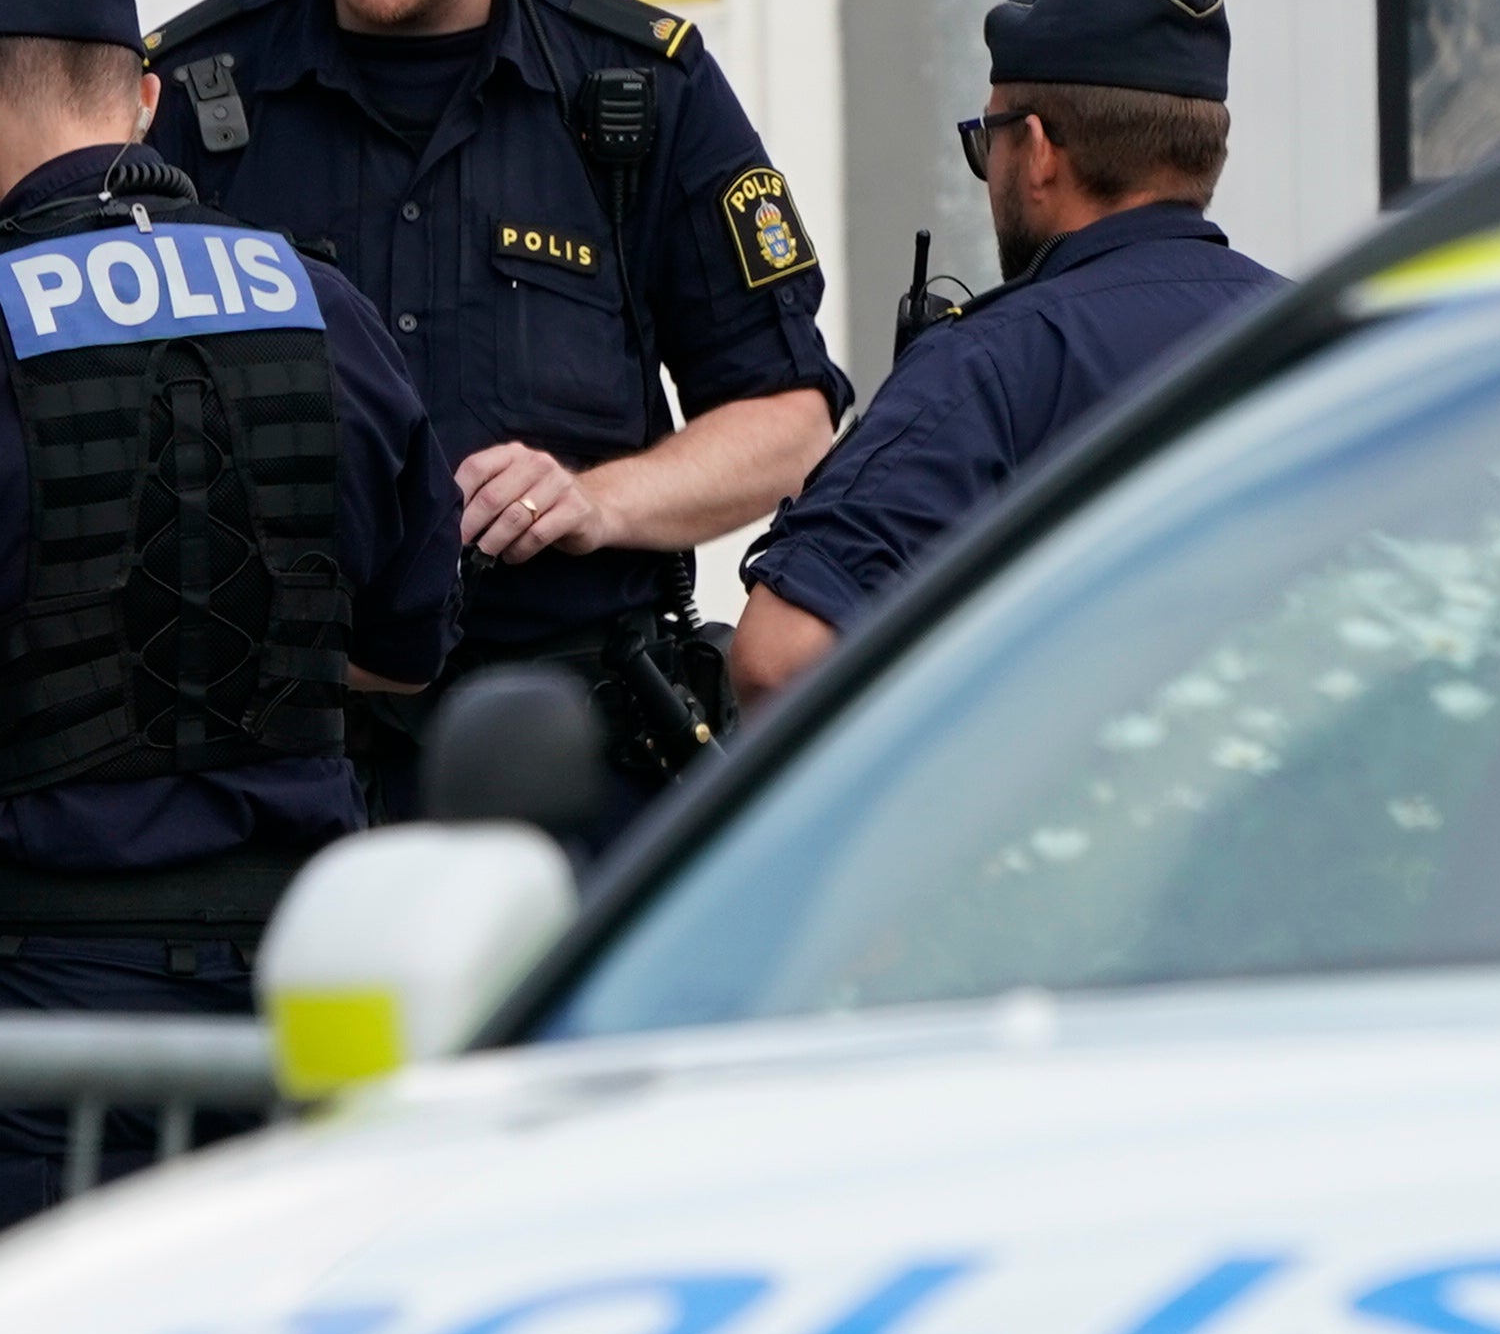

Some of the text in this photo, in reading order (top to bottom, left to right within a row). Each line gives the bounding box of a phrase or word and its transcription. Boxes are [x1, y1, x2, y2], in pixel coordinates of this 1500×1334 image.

[730, 174, 782, 213] POLIS
[502, 227, 592, 266] POLIS
[10, 236, 298, 336] POLIS
